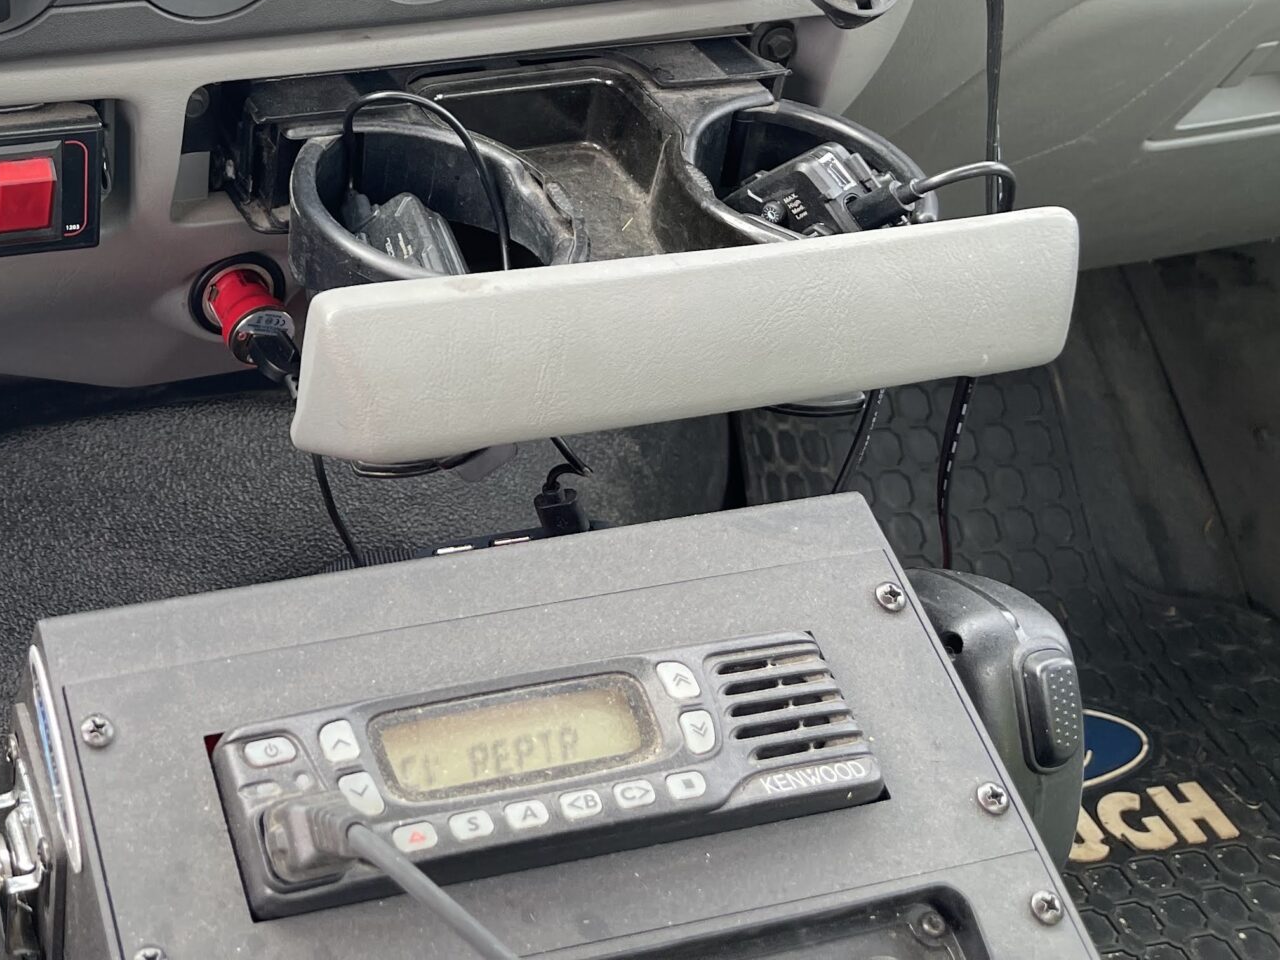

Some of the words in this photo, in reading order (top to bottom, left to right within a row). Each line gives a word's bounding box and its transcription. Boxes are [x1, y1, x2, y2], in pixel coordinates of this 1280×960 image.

[759, 760, 866, 795] KENWOOD
[521, 805, 539, 821] A
[466, 815, 479, 833] S
